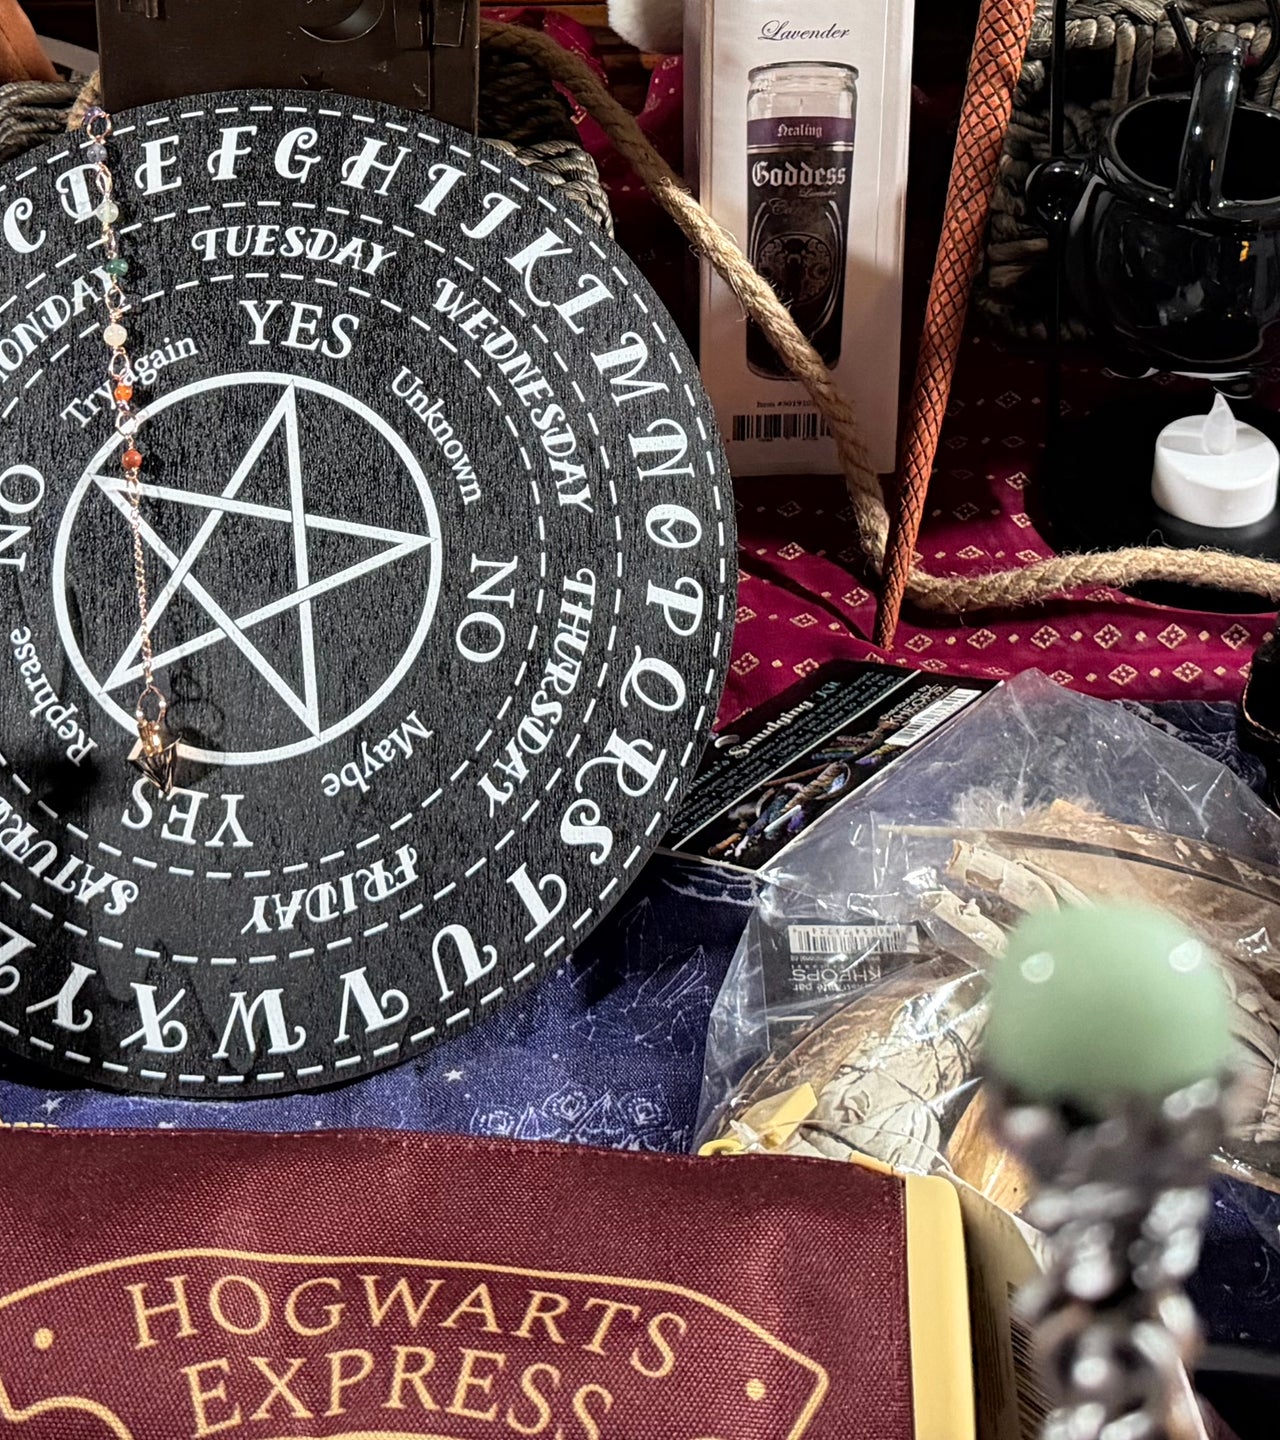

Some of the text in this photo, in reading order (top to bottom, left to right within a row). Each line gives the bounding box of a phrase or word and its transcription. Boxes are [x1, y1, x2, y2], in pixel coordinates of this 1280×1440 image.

[757, 19, 851, 42] Lavender
[750, 160, 848, 188] Goddess
[776, 122, 824, 138] Healing
[191, 224, 397, 277] TUESDAY
[239, 298, 360, 360] YES
[60, 336, 199, 430] Try again
[434, 277, 594, 514] WEDNESDAY
[390, 365, 481, 507] Unknown
[456, 553, 518, 663] NO
[10, 625, 98, 766] Rephrase
[477, 568, 595, 818] THURSDAY
[728, 700, 814, 758] Smudging
[321, 710, 434, 797] Maybe
[121, 777, 253, 848] YES
[241, 844, 419, 934] FRIDAY
[126, 1273, 687, 1379] HOGWARTS
[180, 1344, 612, 1440] EXPRESS
